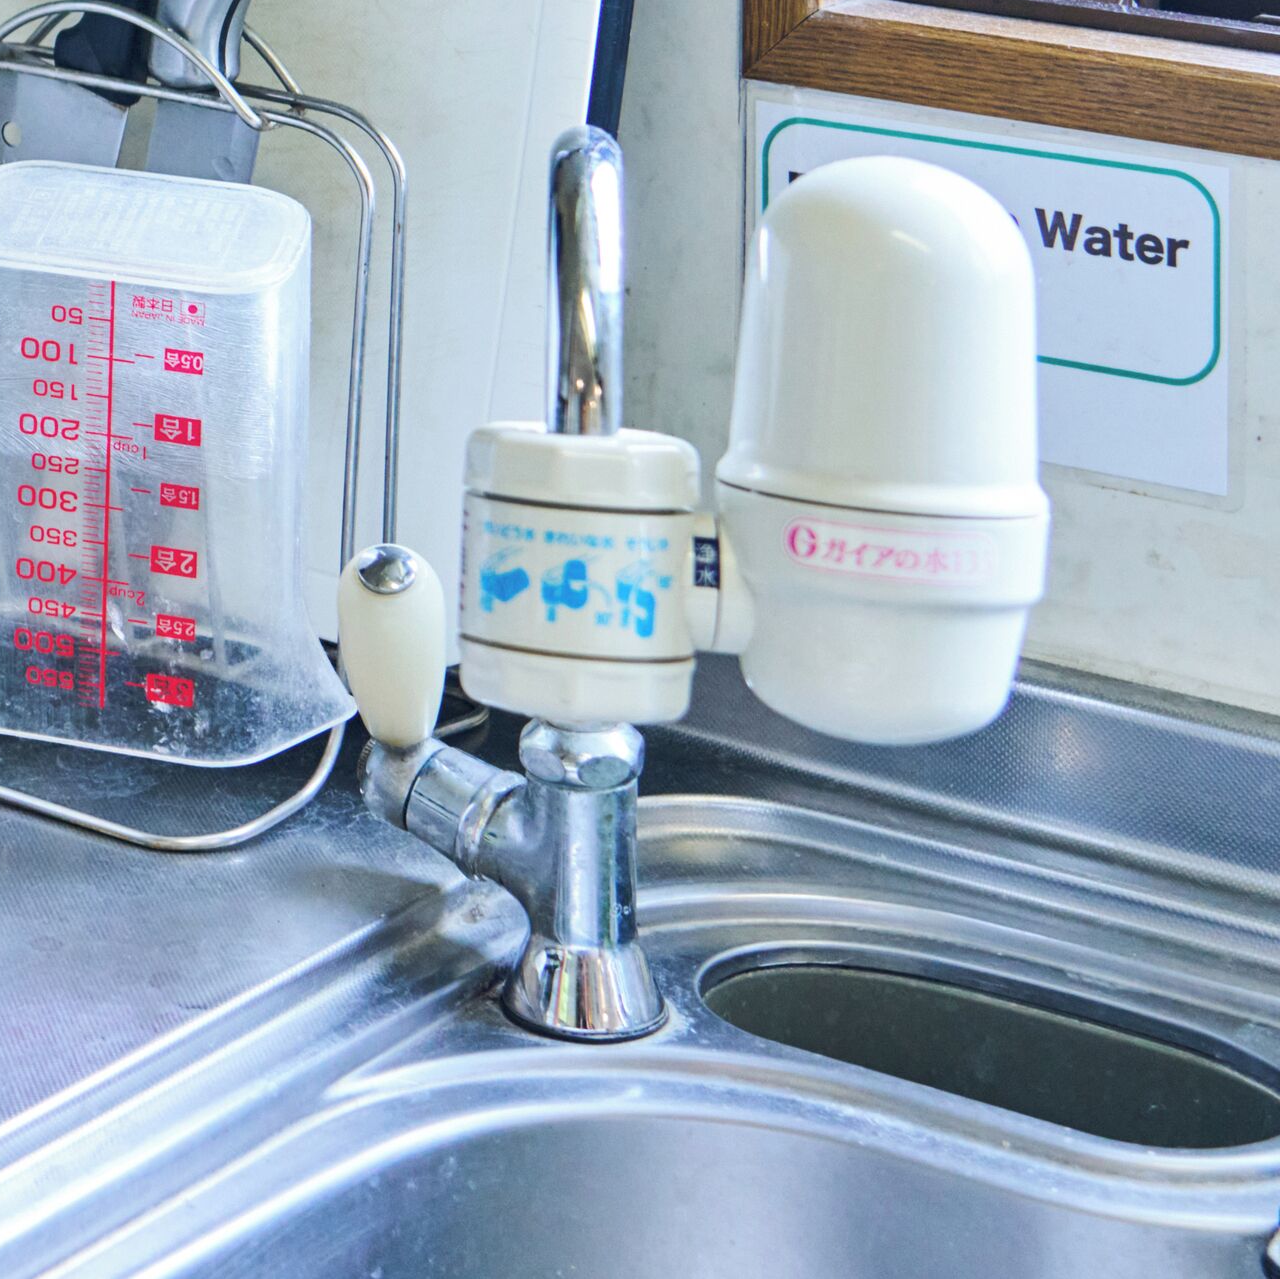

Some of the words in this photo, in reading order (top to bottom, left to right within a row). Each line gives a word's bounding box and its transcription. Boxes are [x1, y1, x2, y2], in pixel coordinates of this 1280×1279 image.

[1035, 207, 1190, 268] Water
[51, 305, 83, 326] 50
[131, 311, 163, 322] JAPAN
[132, 295, 173, 313] 日本製
[165, 314, 176, 324] IN
[180, 314, 205, 327] MADE
[20, 335, 79, 367] 100
[165, 351, 203, 372] 0.5合
[33, 378, 79, 402] 150
[19, 412, 80, 442] 200
[159, 417, 196, 442] 1合
[31, 451, 80, 476] 250
[17, 483, 79, 514] 300
[161, 487, 198, 506] 1.5合
[29, 524, 78, 549] 350
[16, 556, 79, 587] 400
[155, 549, 194, 574] 2合
[695, 542, 717, 586] 浄水
[28, 595, 77, 620] 450
[157, 617, 195, 636] 2.5合
[13, 626, 76, 658] 500
[26, 665, 75, 691] 550
